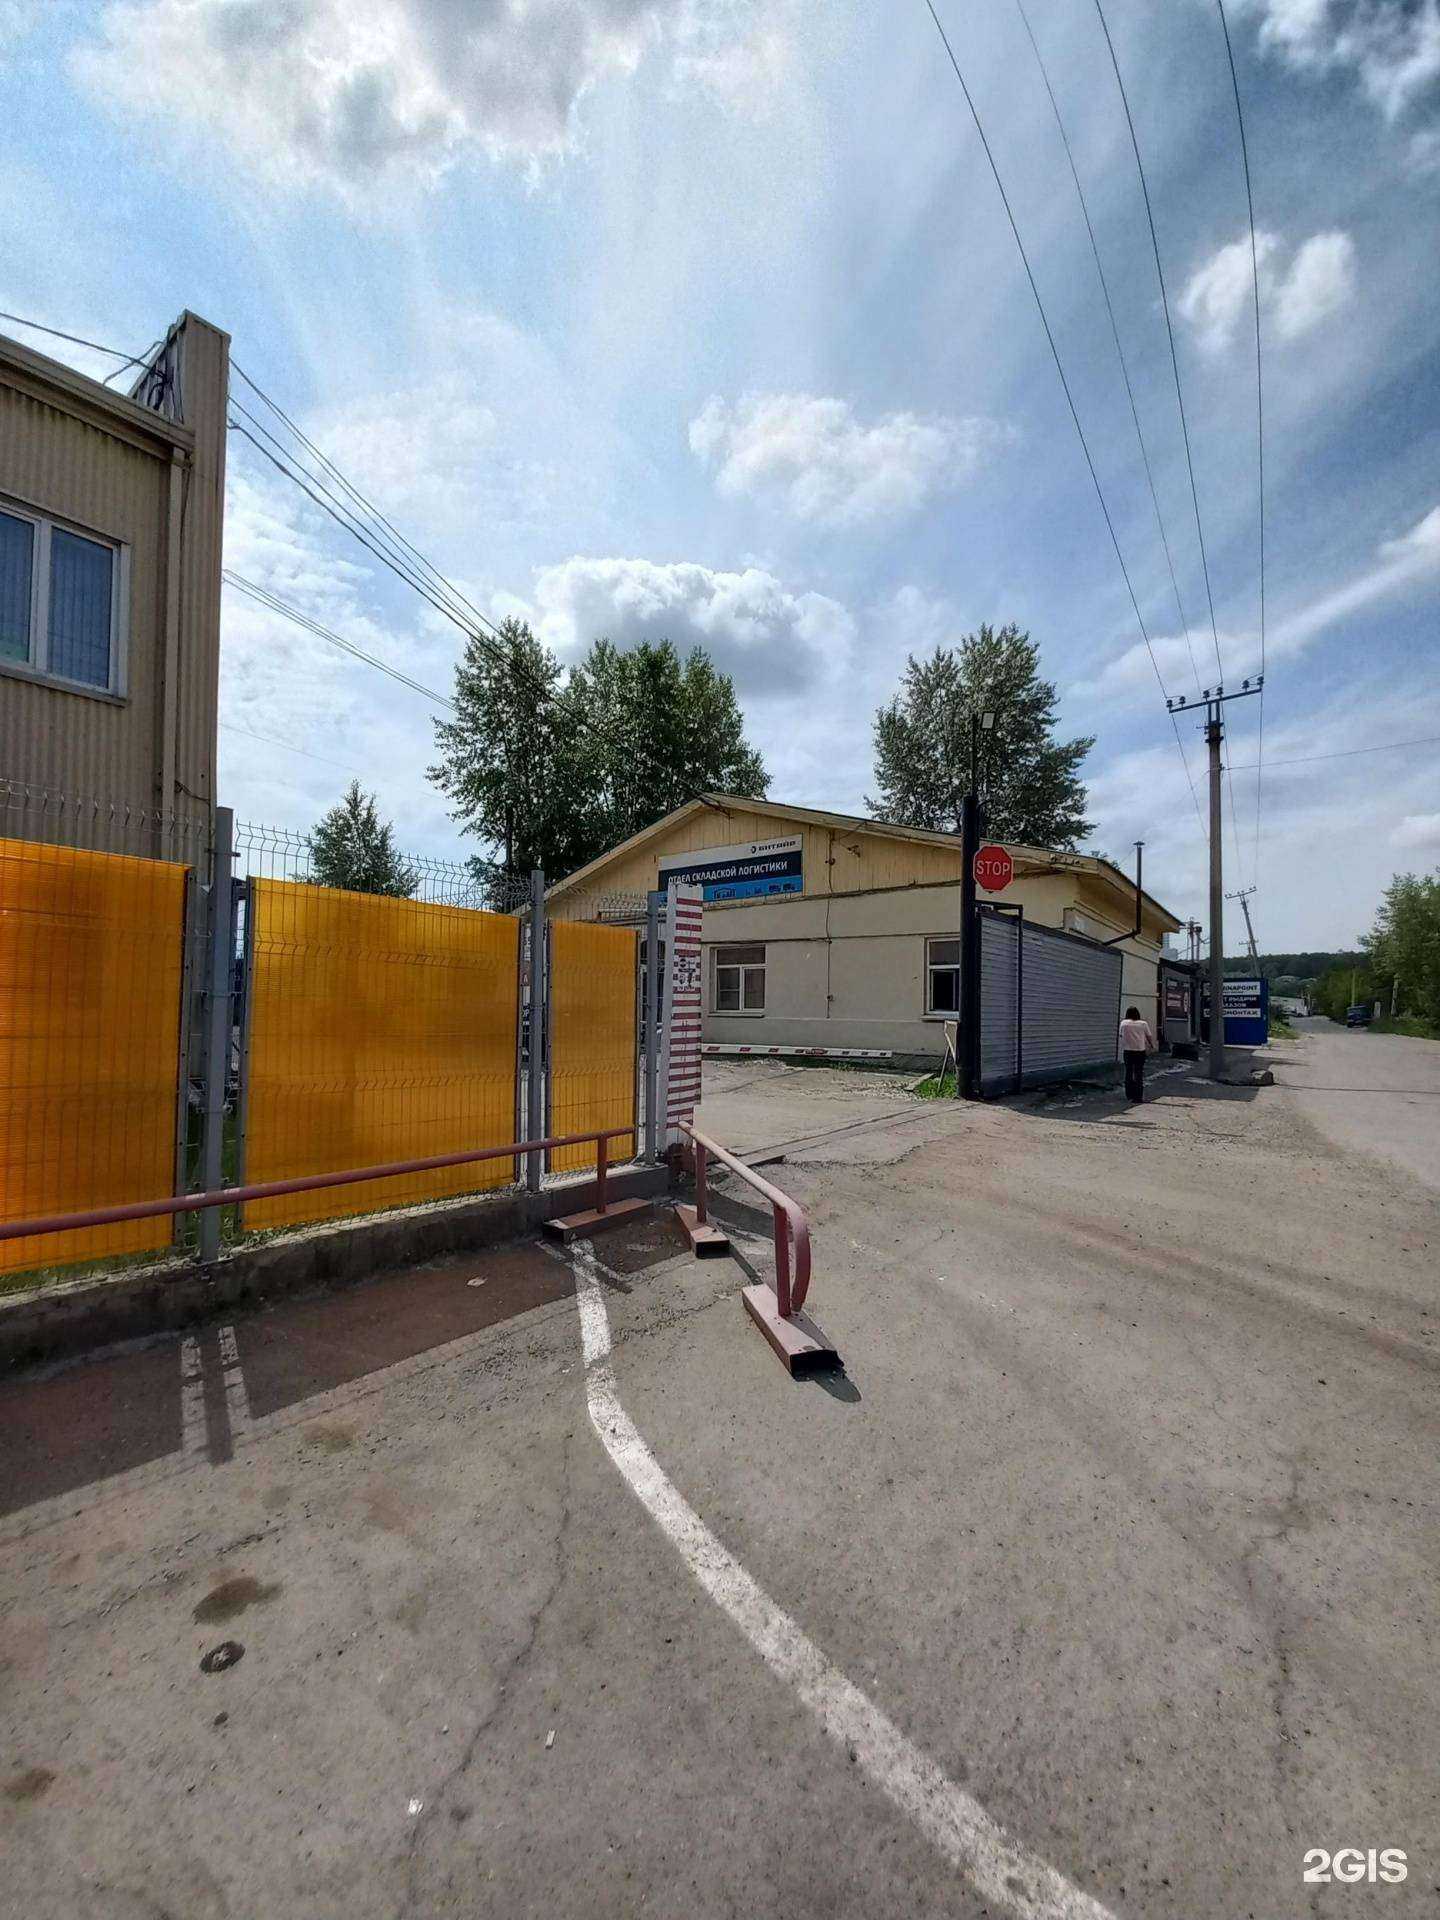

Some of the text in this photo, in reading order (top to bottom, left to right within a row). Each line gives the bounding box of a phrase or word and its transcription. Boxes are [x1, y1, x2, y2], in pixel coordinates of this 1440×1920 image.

[668, 861, 788, 884] ОТДЕЛ СКЛАДСКОЙ ЛОГИСТИКИ
[976, 860, 1010, 875] STOP
